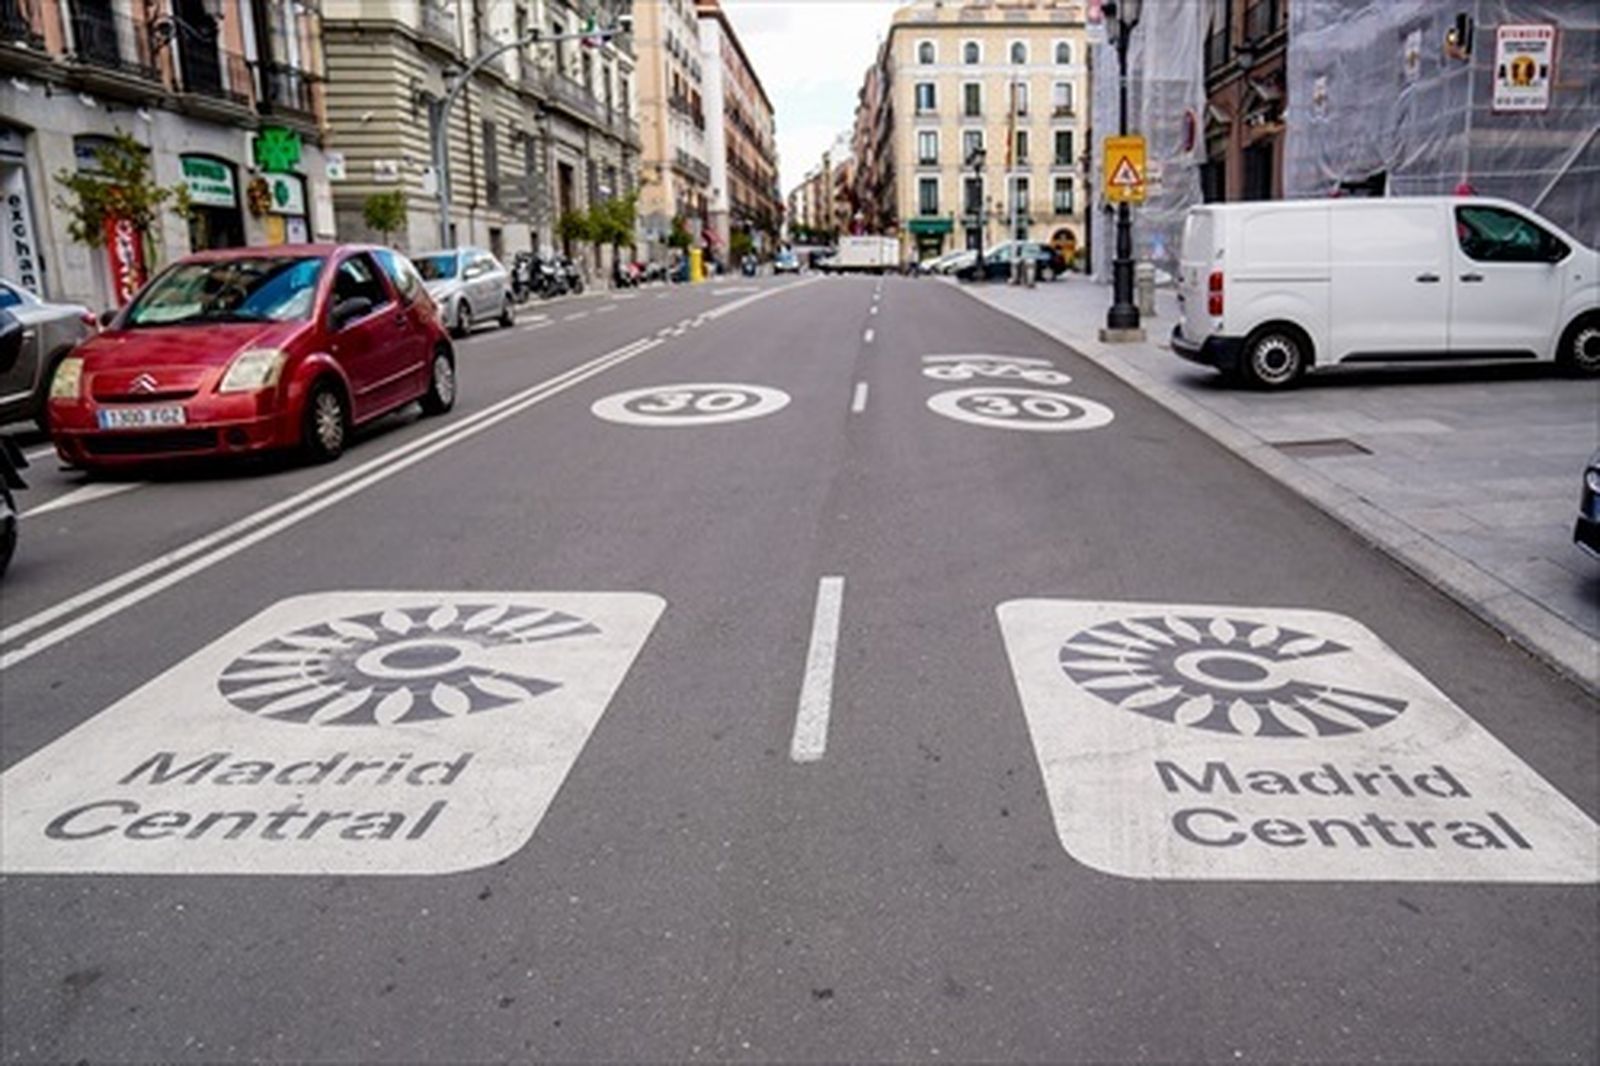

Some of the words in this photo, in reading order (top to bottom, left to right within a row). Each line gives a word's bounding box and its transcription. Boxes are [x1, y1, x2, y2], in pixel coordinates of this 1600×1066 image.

[638, 392, 747, 411] 30
[972, 396, 1070, 417] 30
[117, 752, 475, 786] Madrid
[1154, 760, 1472, 798] Madrid
[44, 799, 448, 840] Central
[1171, 807, 1533, 850] Central
